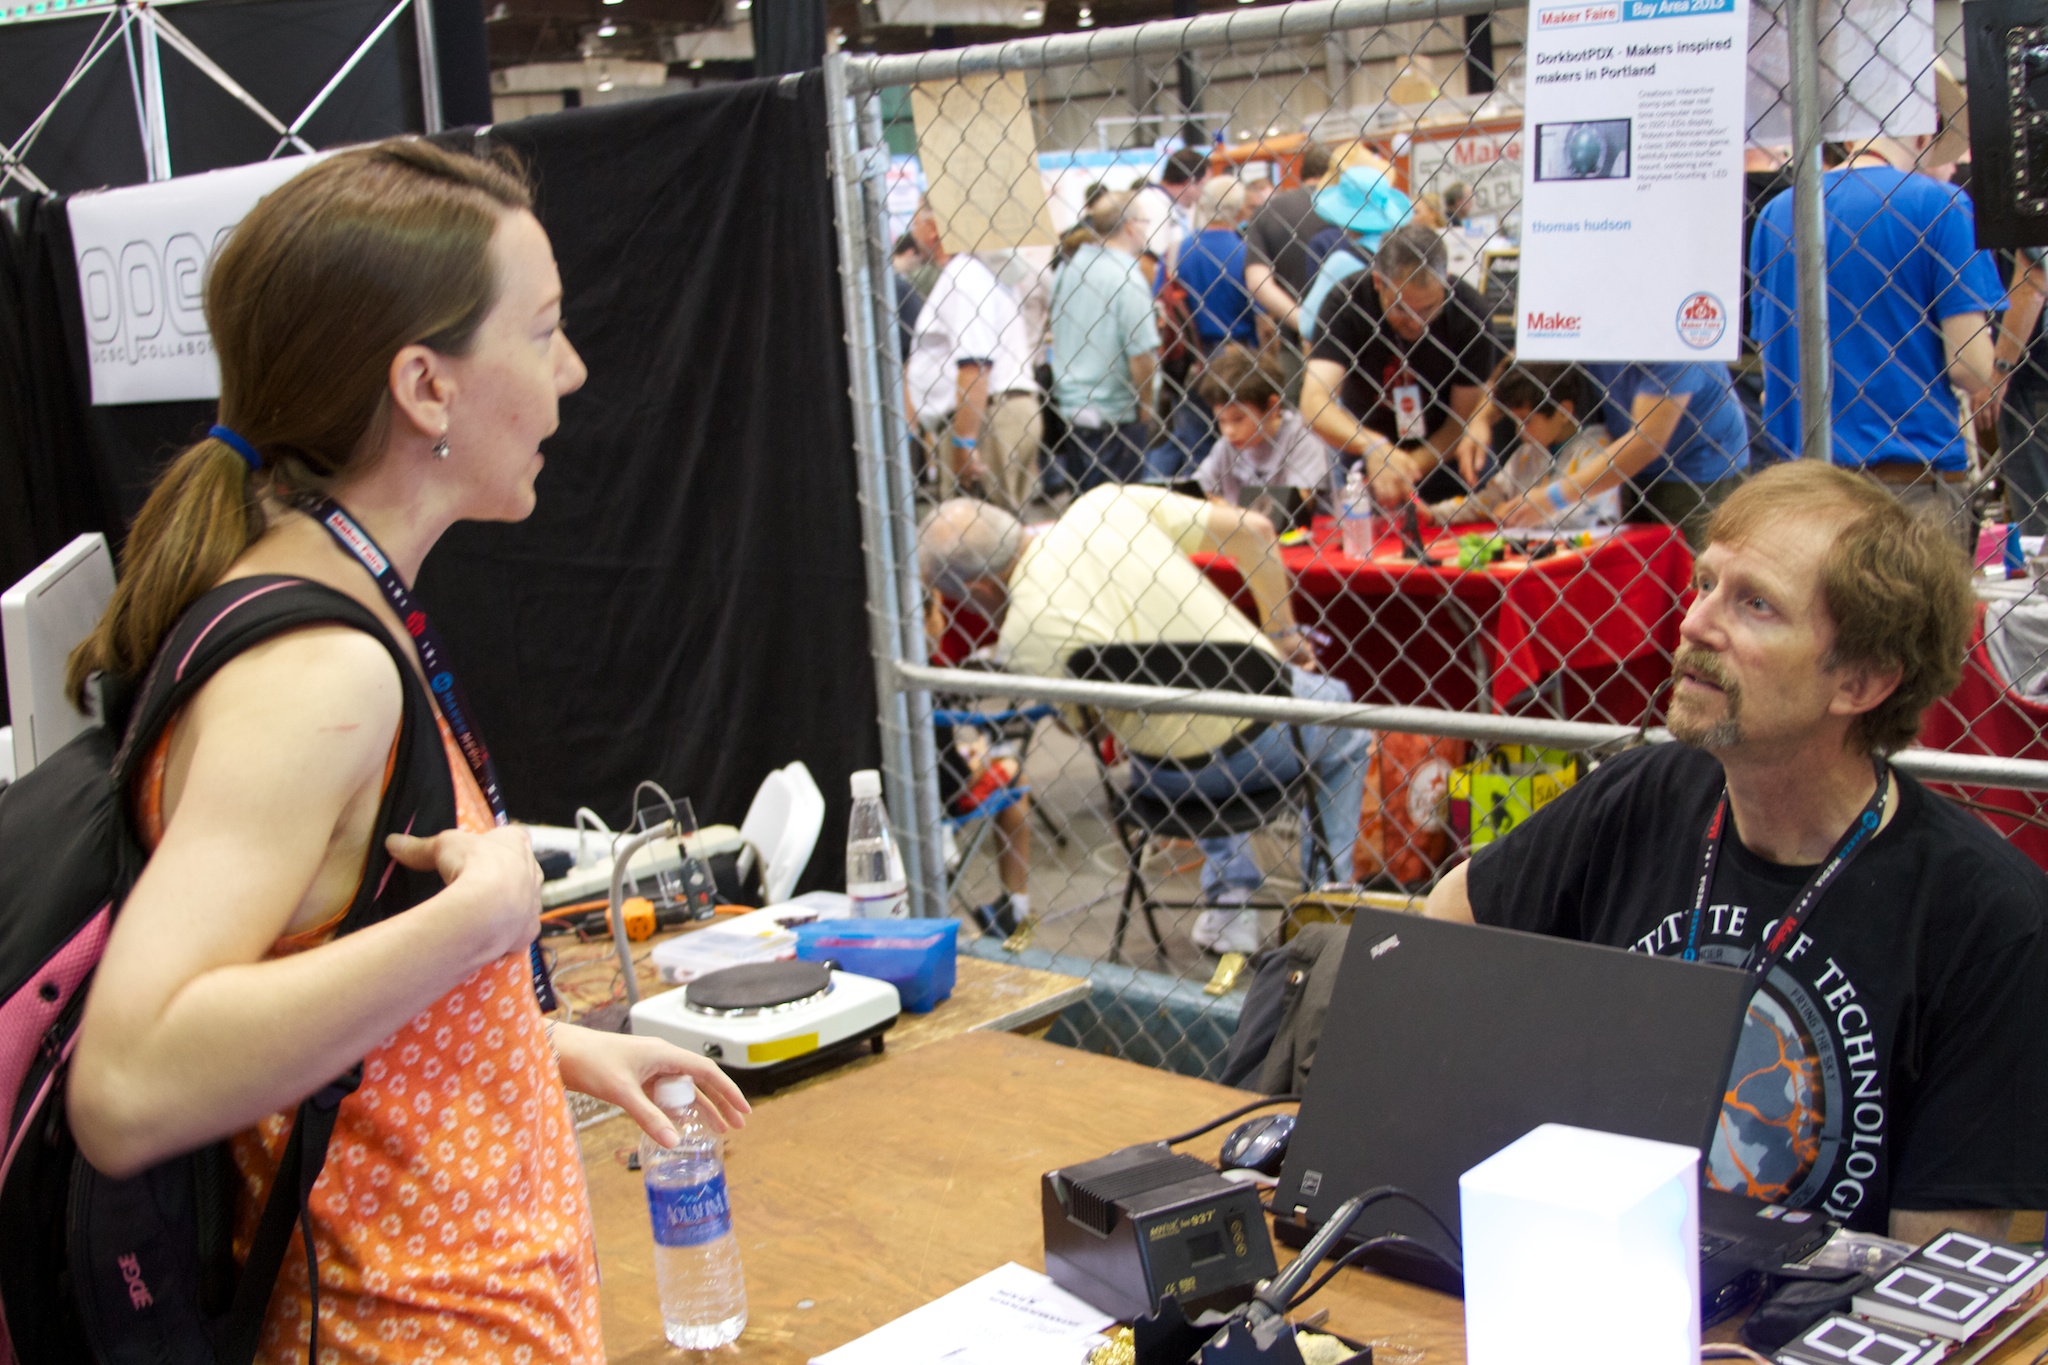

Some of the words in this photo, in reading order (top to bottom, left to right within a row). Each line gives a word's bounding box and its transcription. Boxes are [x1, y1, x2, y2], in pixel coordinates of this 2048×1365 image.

[1541, 11, 1580, 26] Maker
[1584, 8, 1616, 21] Faire
[1631, 1, 1655, 18] Bay
[1660, 0, 1690, 14] Area
[1691, 0, 1726, 11] 2013
[1536, 45, 1614, 66] DorkbotPDX
[1626, 41, 1673, 58] Makers
[1677, 36, 1732, 54] inspired
[1535, 68, 1582, 85] makers
[1585, 66, 1596, 80] in
[1600, 63, 1656, 80] Portland
[1532, 219, 1581, 234] thomas
[1584, 218, 1632, 233] hudson
[1526, 311, 1582, 331] Make:
[1790, 987, 1819, 1029] FRYING
[1814, 1026, 1832, 1053] THE
[1822, 1054, 1837, 1081] SKY
[1813, 957, 1885, 1220] TECHNOLOGY
[117, 1251, 154, 1312] EDGE
